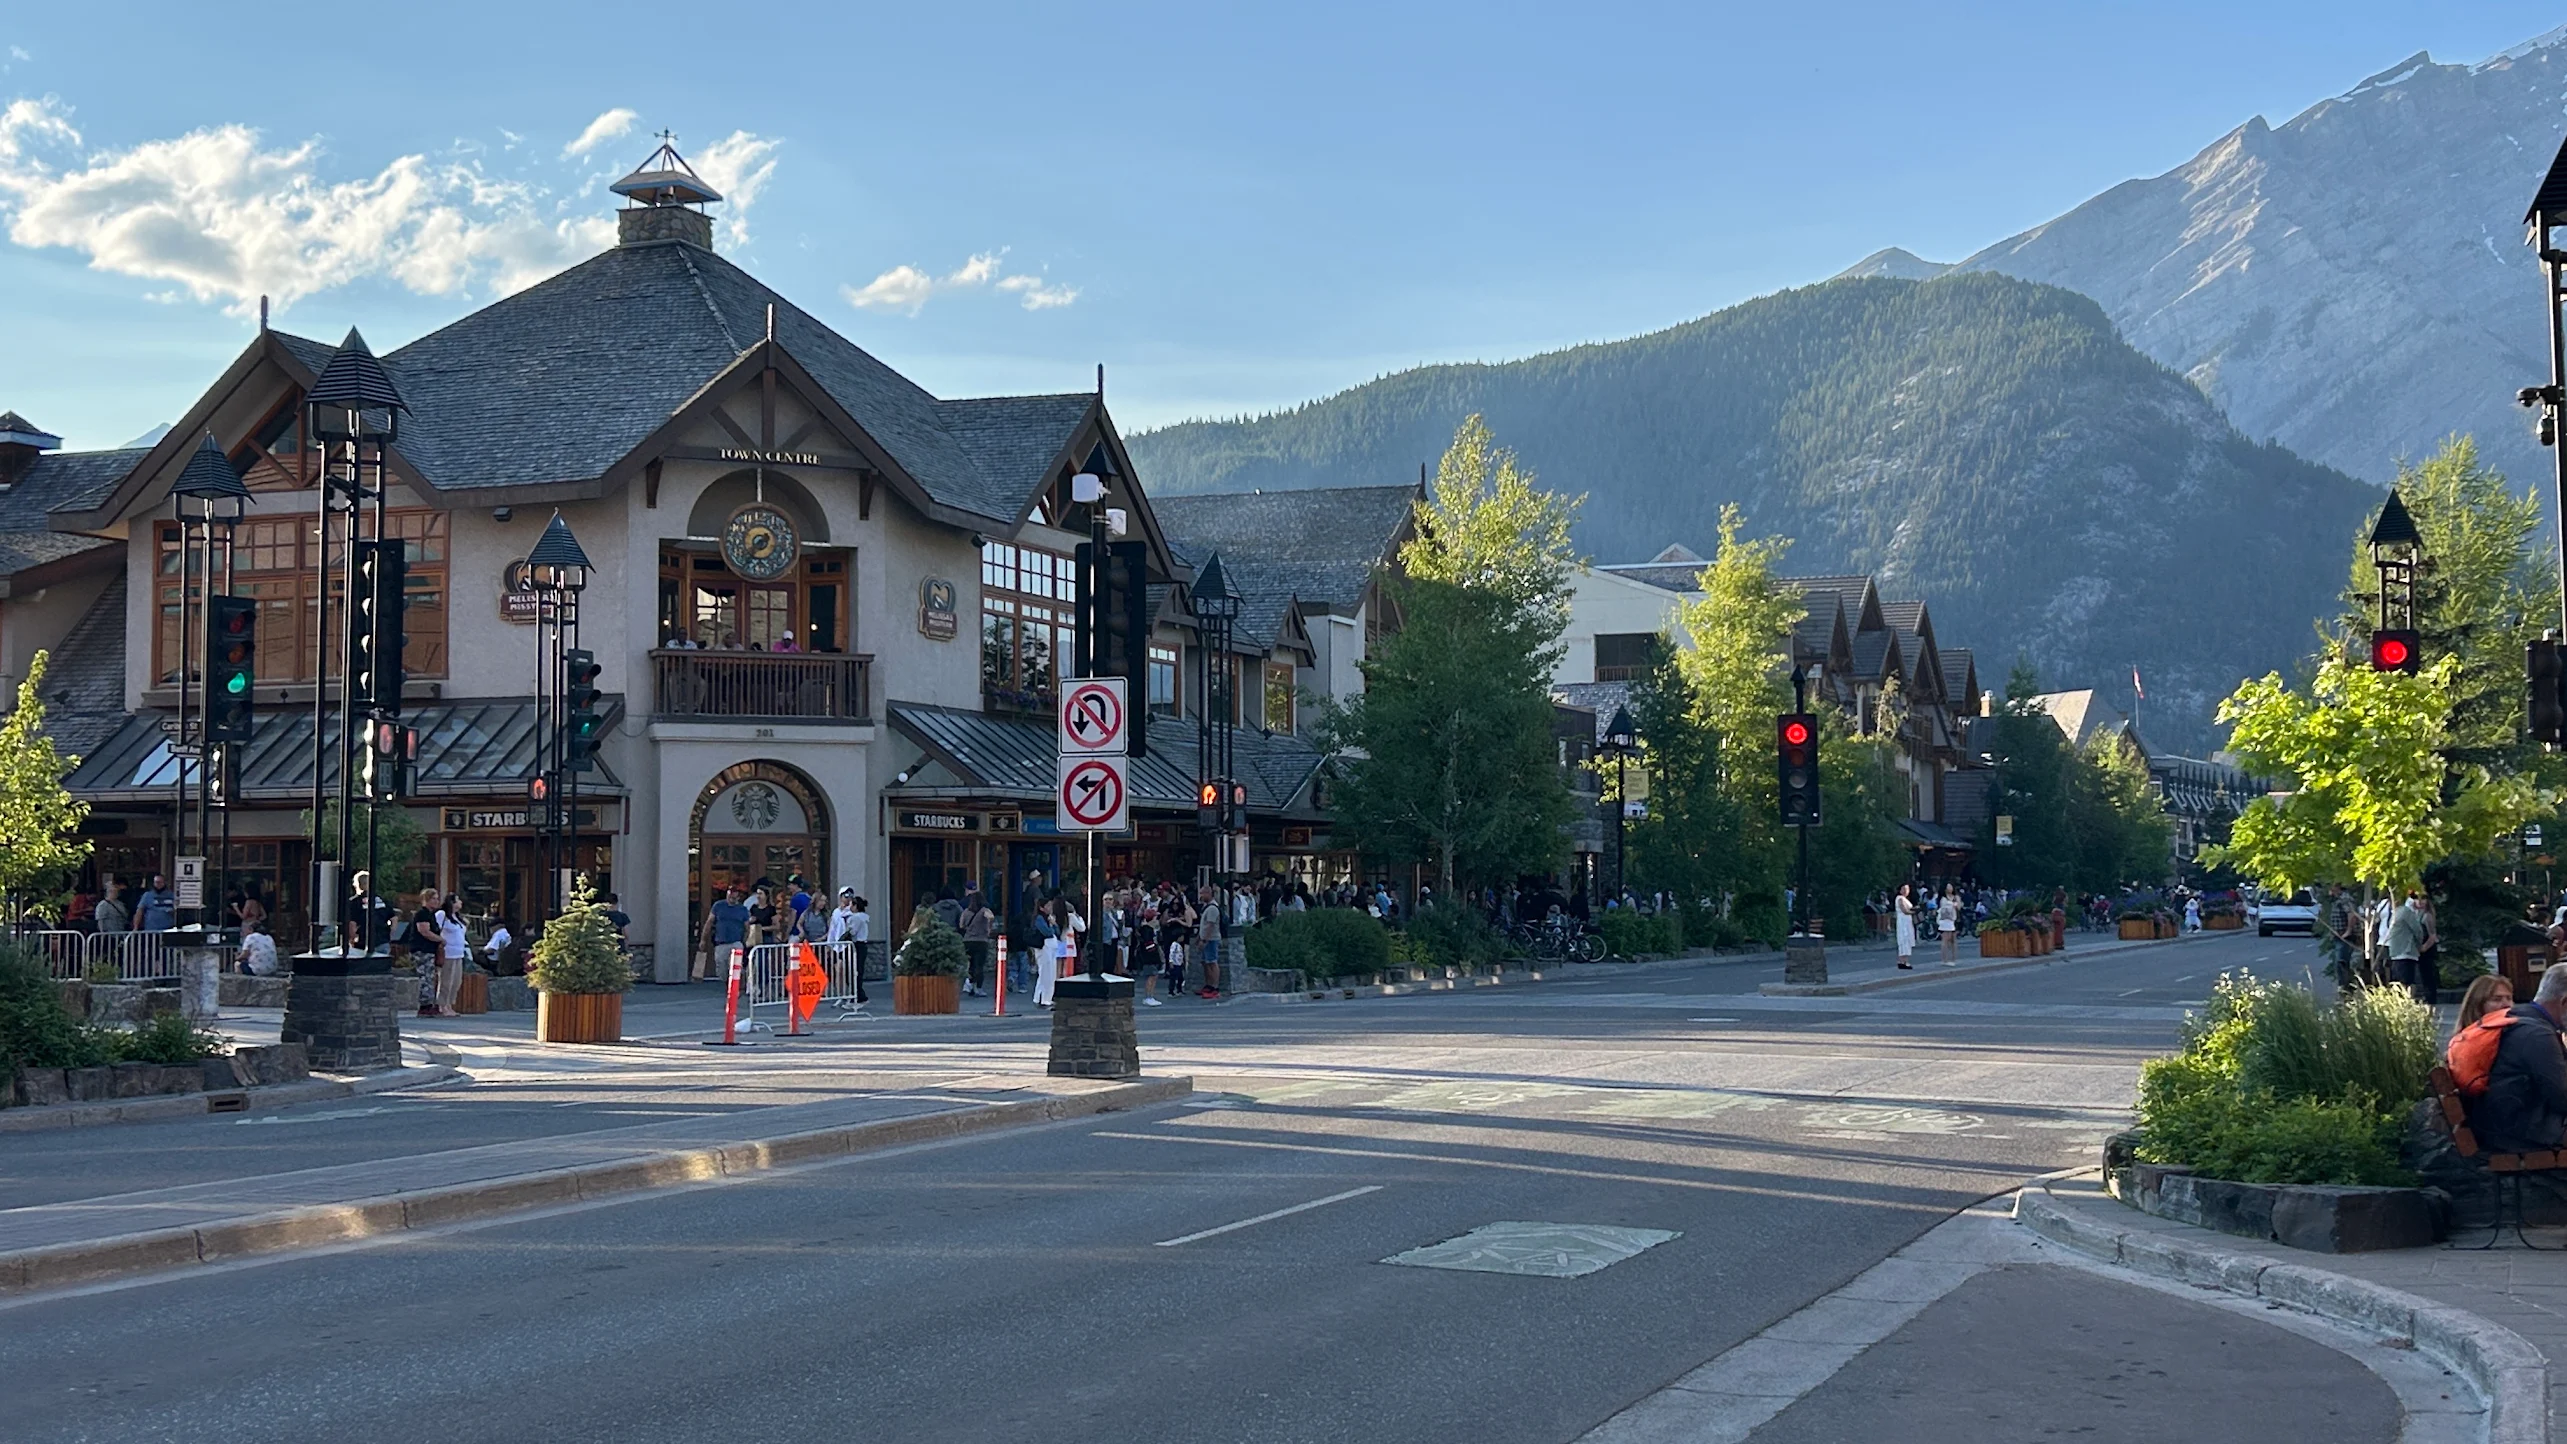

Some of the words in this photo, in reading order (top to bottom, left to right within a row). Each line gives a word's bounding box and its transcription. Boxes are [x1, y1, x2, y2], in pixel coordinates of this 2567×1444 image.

[721, 448, 761, 460] TOWN
[766, 452, 820, 464] CENTRE
[473, 812, 569, 827] STARBS
[914, 814, 965, 829] STARBUCKS
[798, 963, 816, 976] OAD
[798, 981, 821, 996] LOSED
